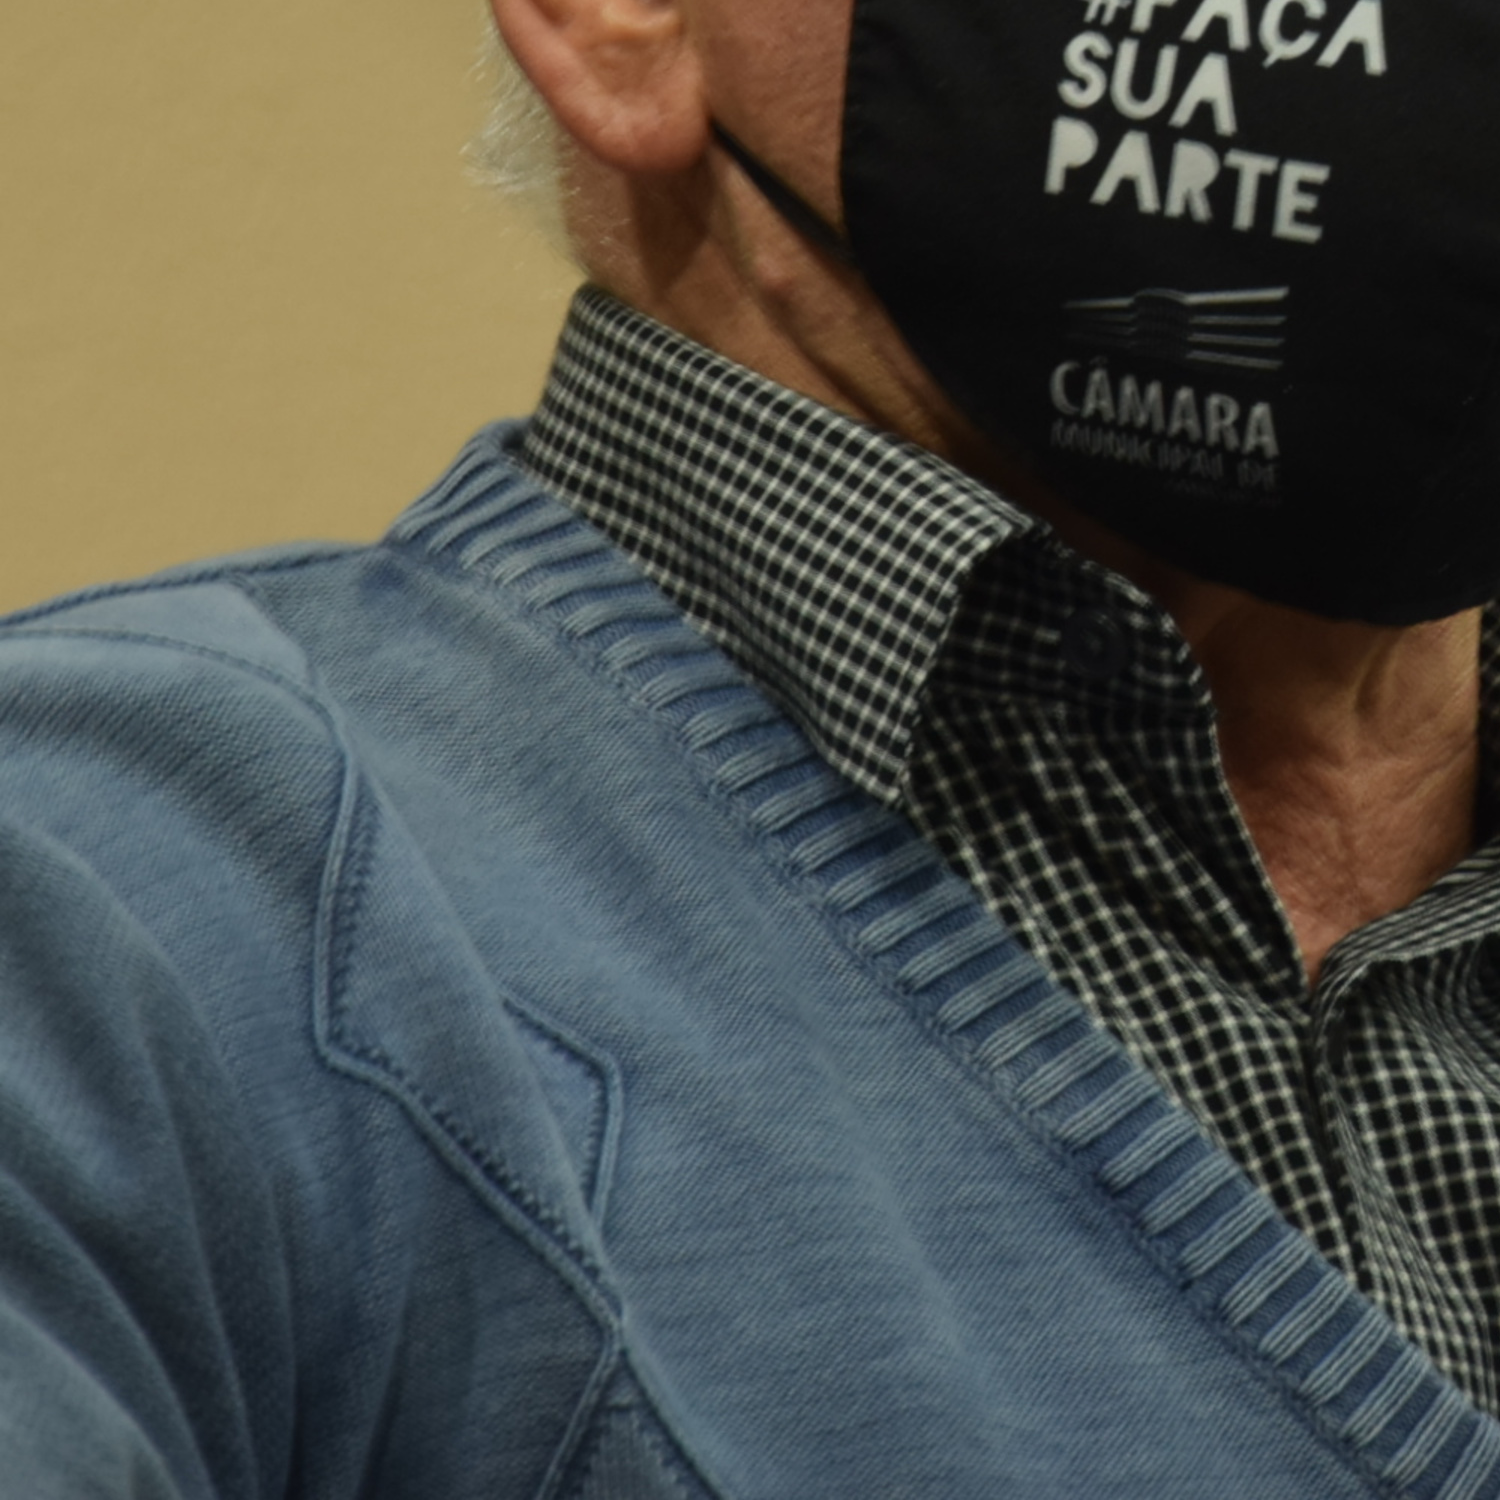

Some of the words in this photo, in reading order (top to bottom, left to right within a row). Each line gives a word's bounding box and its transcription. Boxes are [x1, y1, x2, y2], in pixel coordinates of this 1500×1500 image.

[1057, 31, 1237, 136] SUA
[1044, 115, 1331, 243] PARTE
[1050, 355, 1280, 459] CÂMARA
